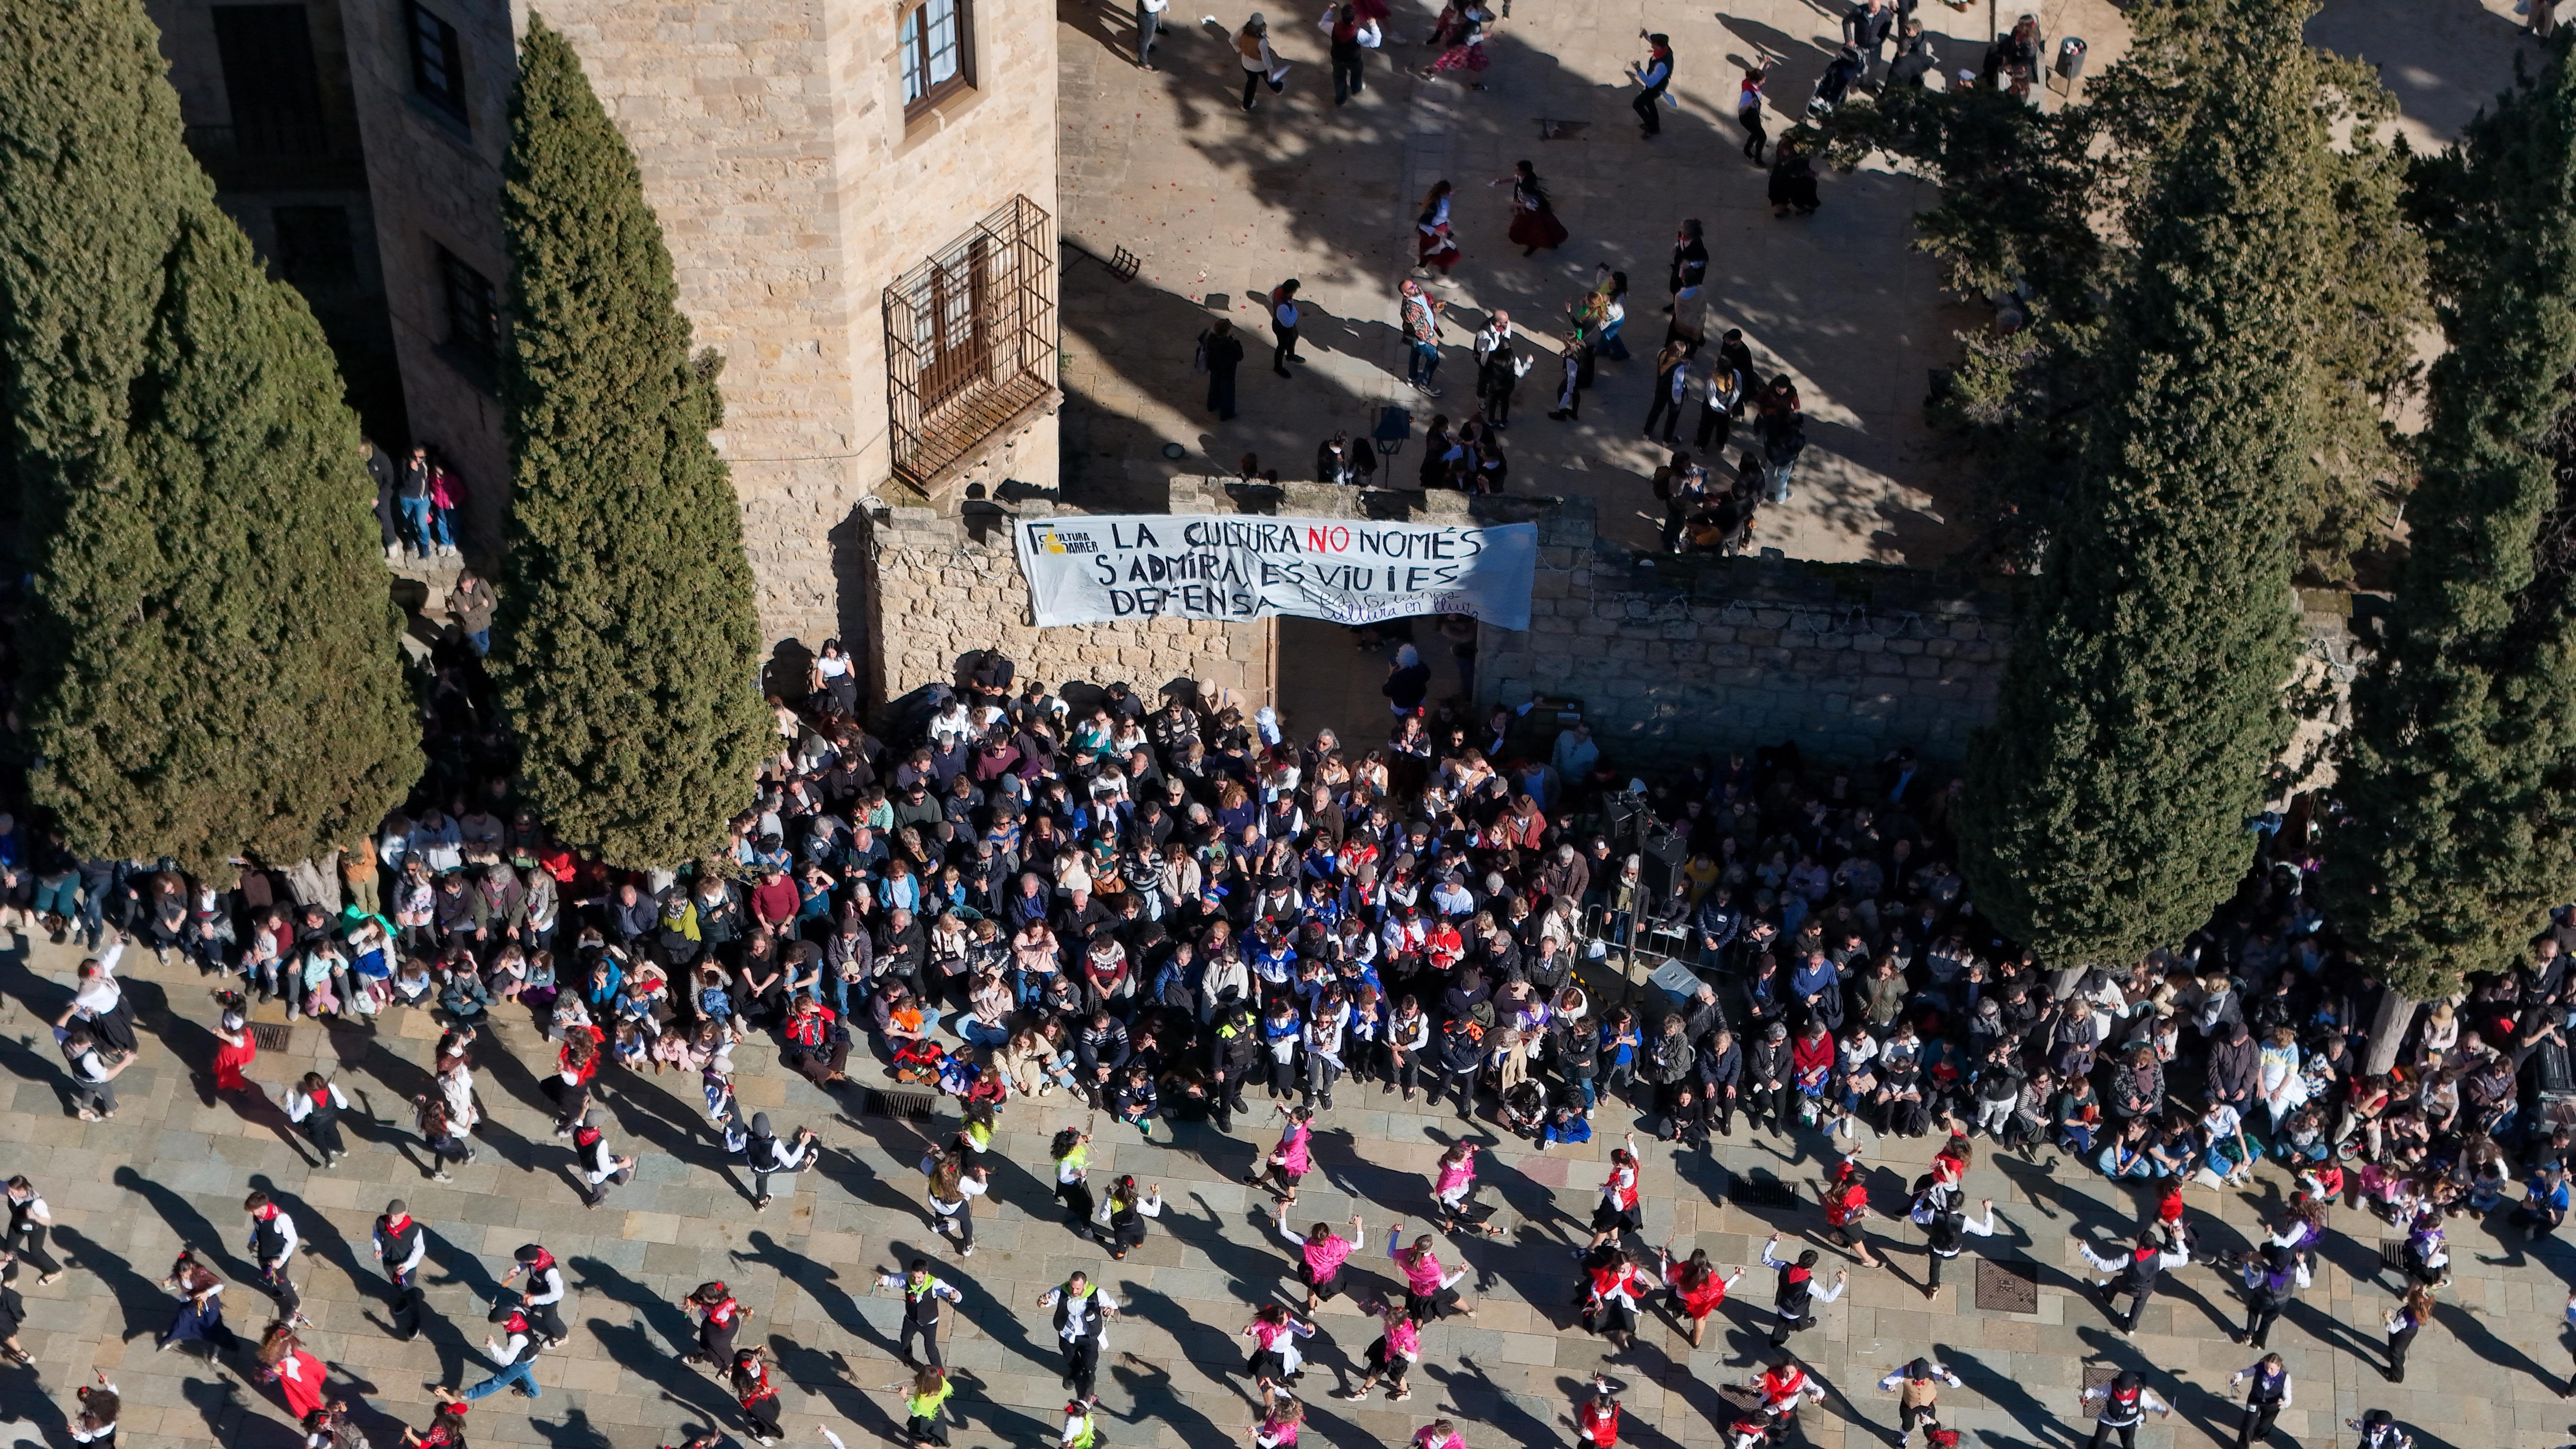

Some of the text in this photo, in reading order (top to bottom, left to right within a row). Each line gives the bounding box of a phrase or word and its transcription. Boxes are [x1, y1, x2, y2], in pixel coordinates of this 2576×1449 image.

[1038, 532, 1090, 543] CULTURA
[1111, 522, 1483, 560] LA CULTURA NO NOMÉS
[1261, 560, 1306, 587] ES
[1406, 565, 1460, 592] ES
[1109, 585, 1278, 618] DEFENSA
[1405, 601, 1422, 613] en
